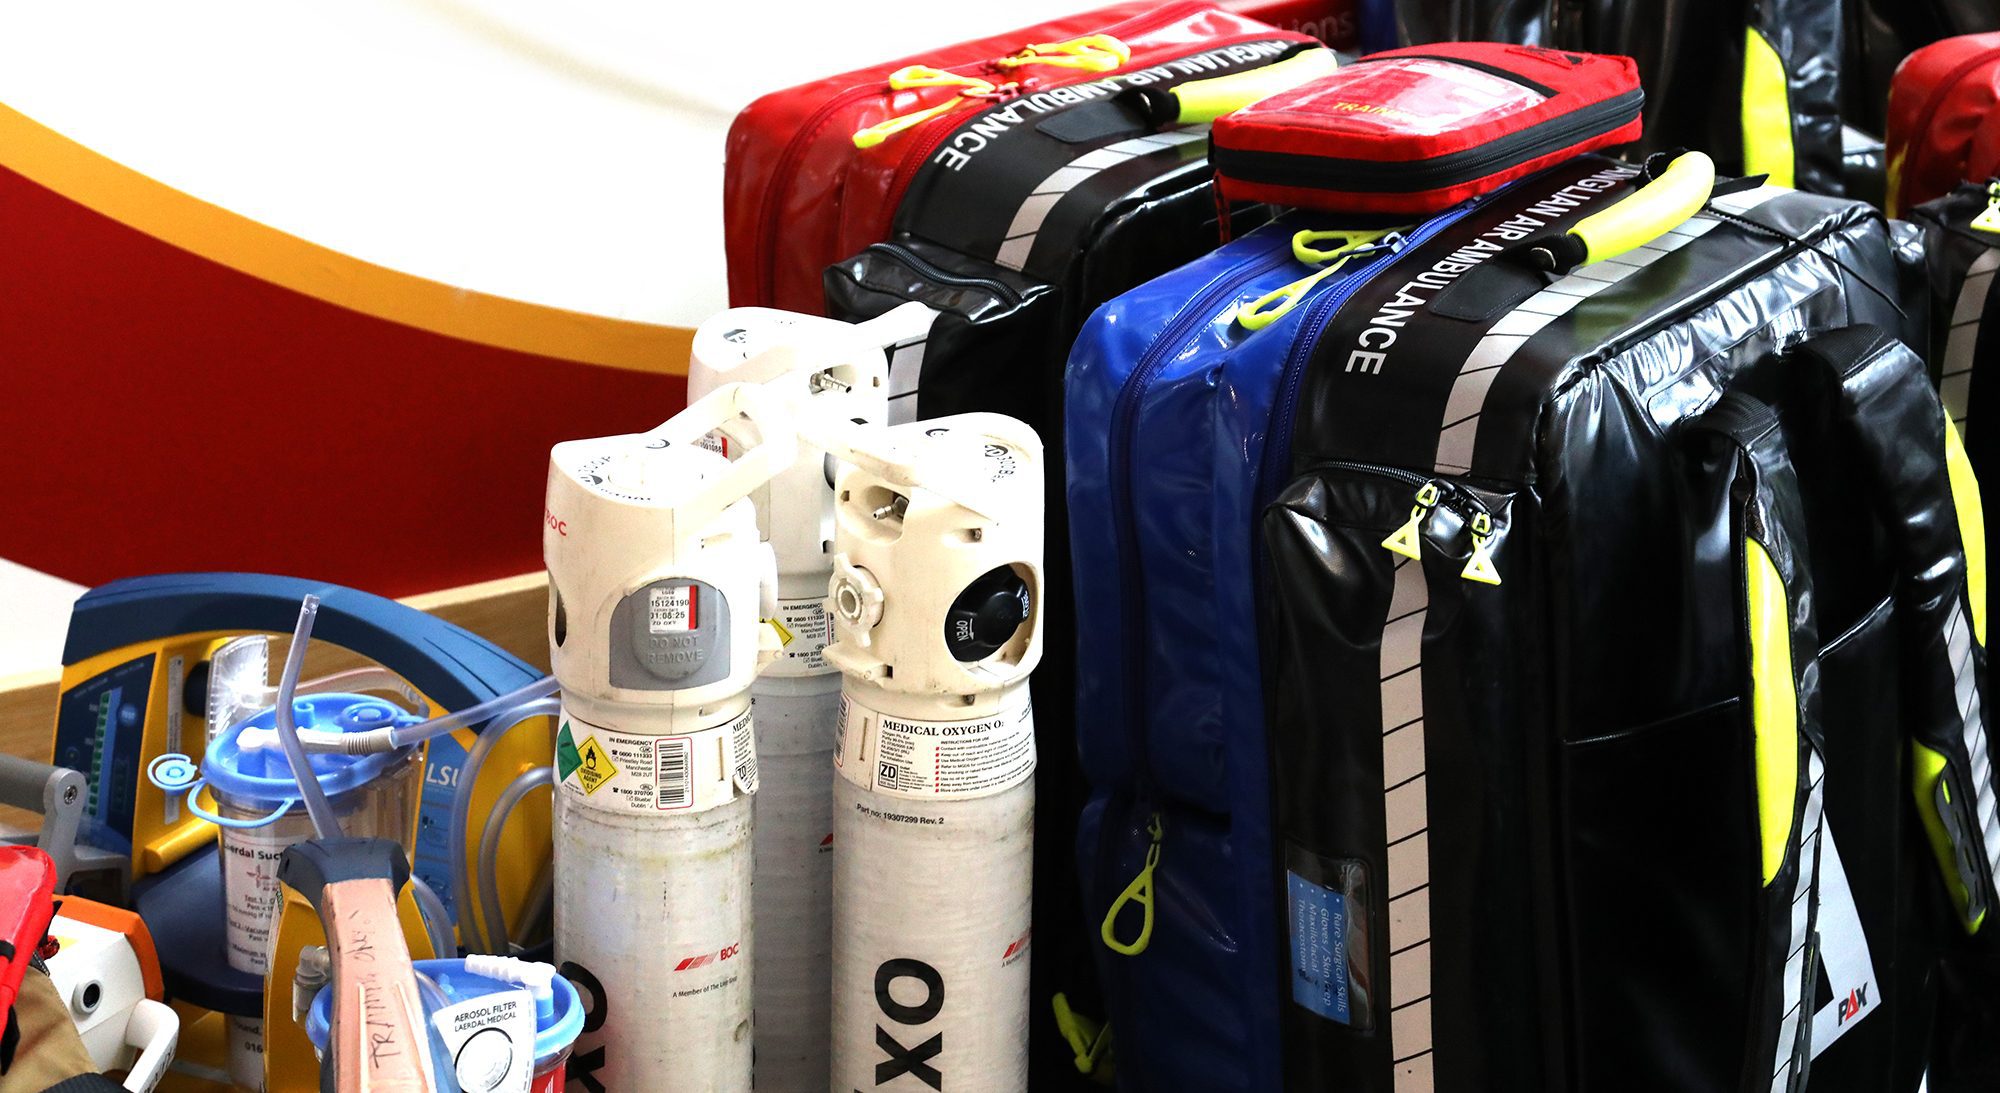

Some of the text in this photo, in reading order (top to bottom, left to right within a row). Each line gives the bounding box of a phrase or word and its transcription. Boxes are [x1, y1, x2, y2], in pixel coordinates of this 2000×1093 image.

[932, 38, 1290, 172] ANGLIAN AIR AMBULANCE
[1333, 101, 1392, 116] TRAIN
[1344, 165, 1642, 376] ANGLIAN AIR AMBULANCE
[956, 620, 970, 642] OPEN
[674, 636, 698, 648] NOT
[648, 648, 704, 664] REMOVE
[882, 720, 940, 736] MEDICAL
[942, 722, 992, 736] OXYGEN
[616, 738, 652, 746] EMERGENCY
[880, 764, 896, 779] ZD
[856, 803, 944, 825] Part no: 19307299 Rev. 2
[258, 850, 283, 861] Suct
[1310, 902, 1320, 973] Maxillofacial
[1320, 918, 1330, 945] Gloves
[720, 942, 739, 961] BOC
[1322, 954, 1332, 980] Skin
[1334, 912, 1347, 1013] Rare Surgical Skills
[678, 988, 702, 997] Member
[454, 1001, 517, 1023] AEROSOL FILTER
[1838, 981, 1868, 1028] PAX
[454, 1011, 517, 1032] LAERDAL MEDICAL
